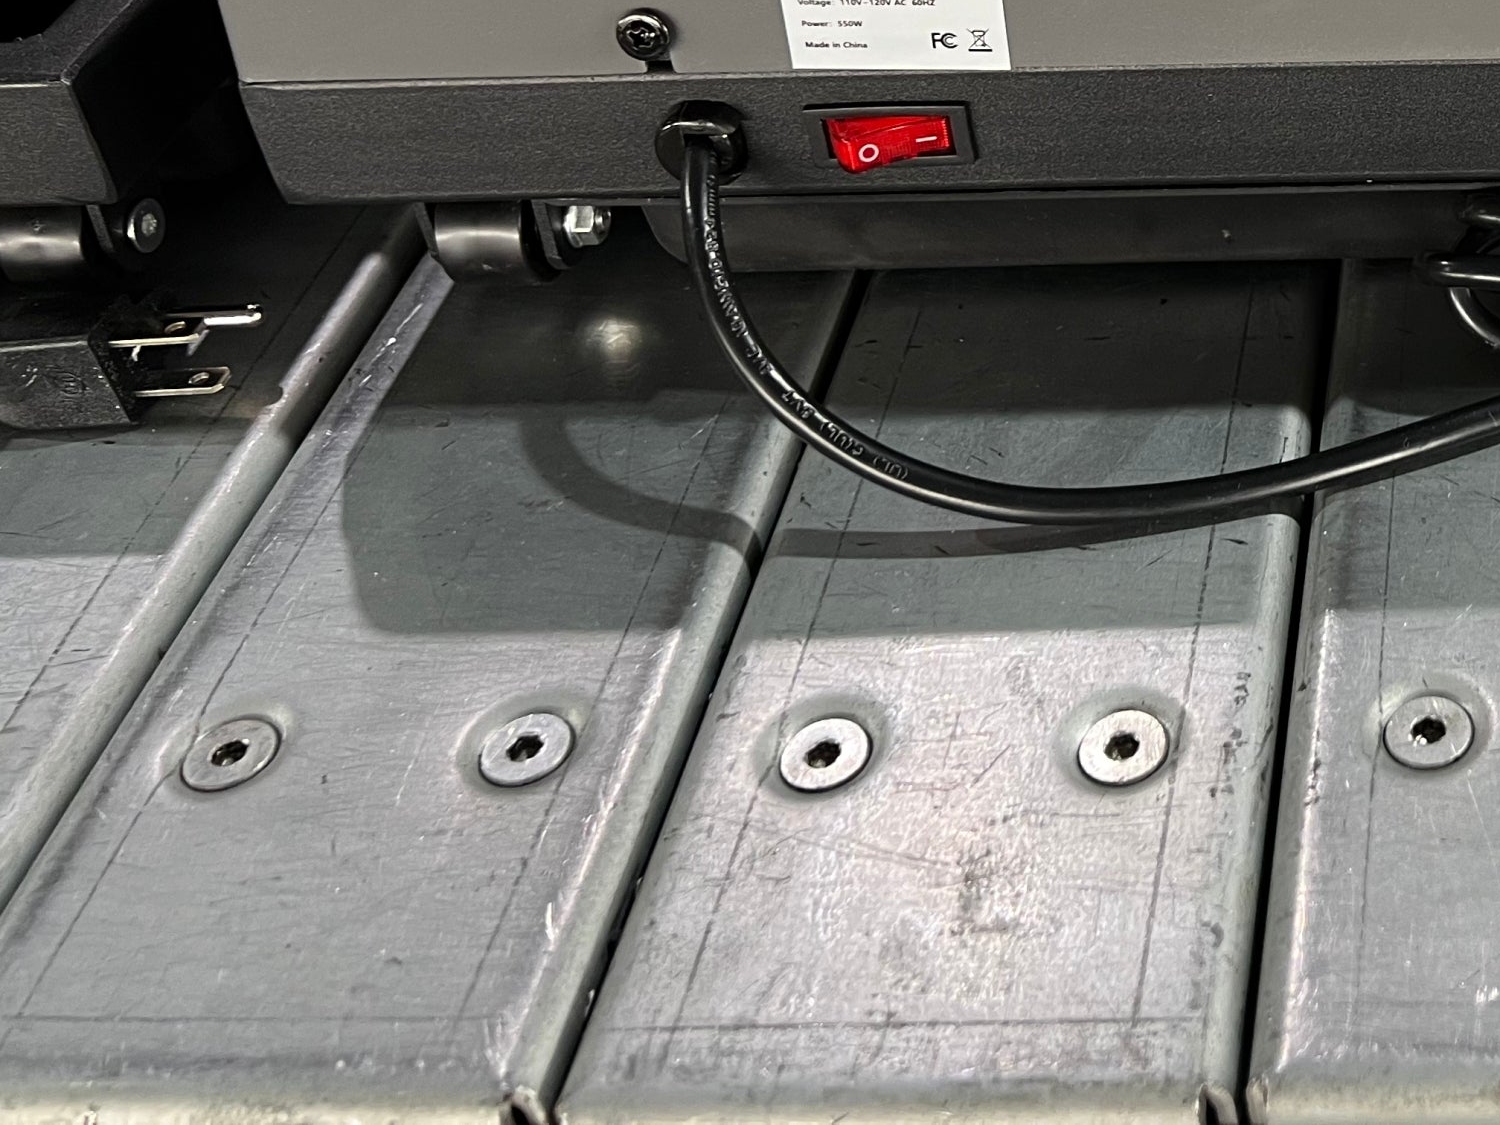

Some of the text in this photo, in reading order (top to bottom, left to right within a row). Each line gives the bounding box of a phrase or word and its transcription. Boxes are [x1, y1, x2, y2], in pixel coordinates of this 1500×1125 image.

[805, 41, 868, 49] Made in China
